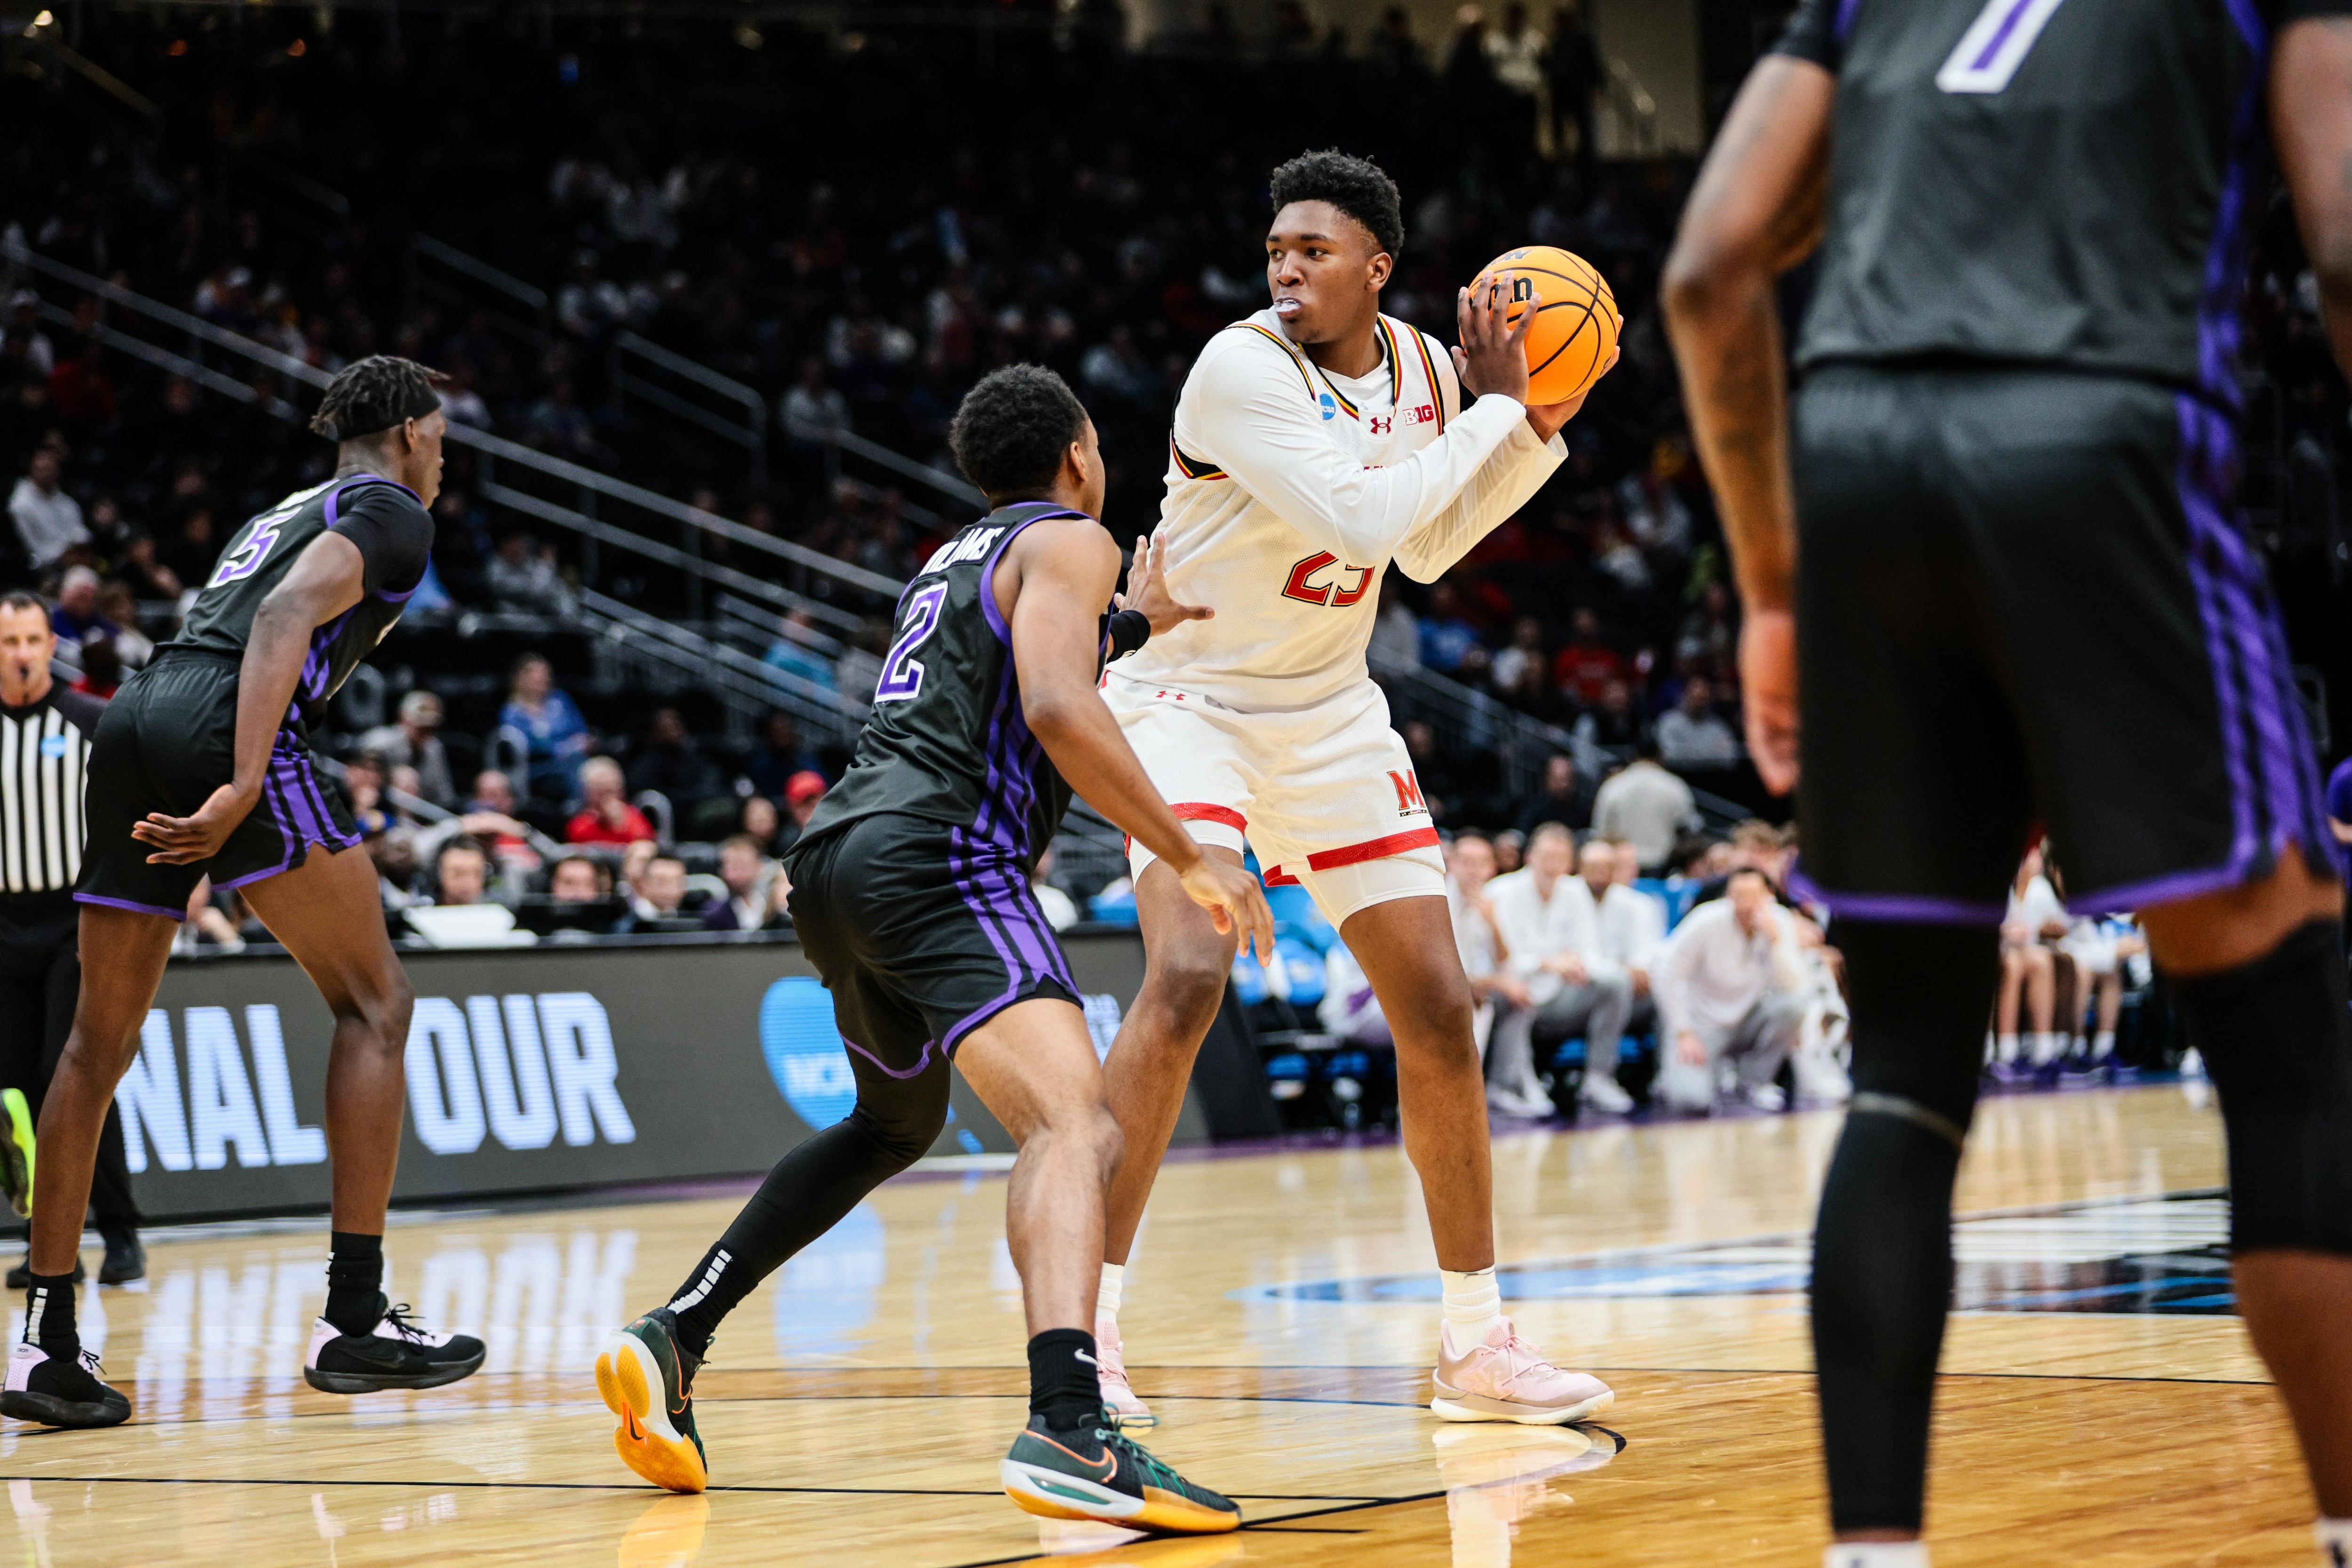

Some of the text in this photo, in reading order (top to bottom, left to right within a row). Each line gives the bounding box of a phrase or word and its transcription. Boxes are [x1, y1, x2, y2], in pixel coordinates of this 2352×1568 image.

[207, 505, 304, 589] 5
[874, 581, 948, 705] 2
[1386, 769, 1426, 811] M
[113, 991, 636, 1174] NAL OUR
